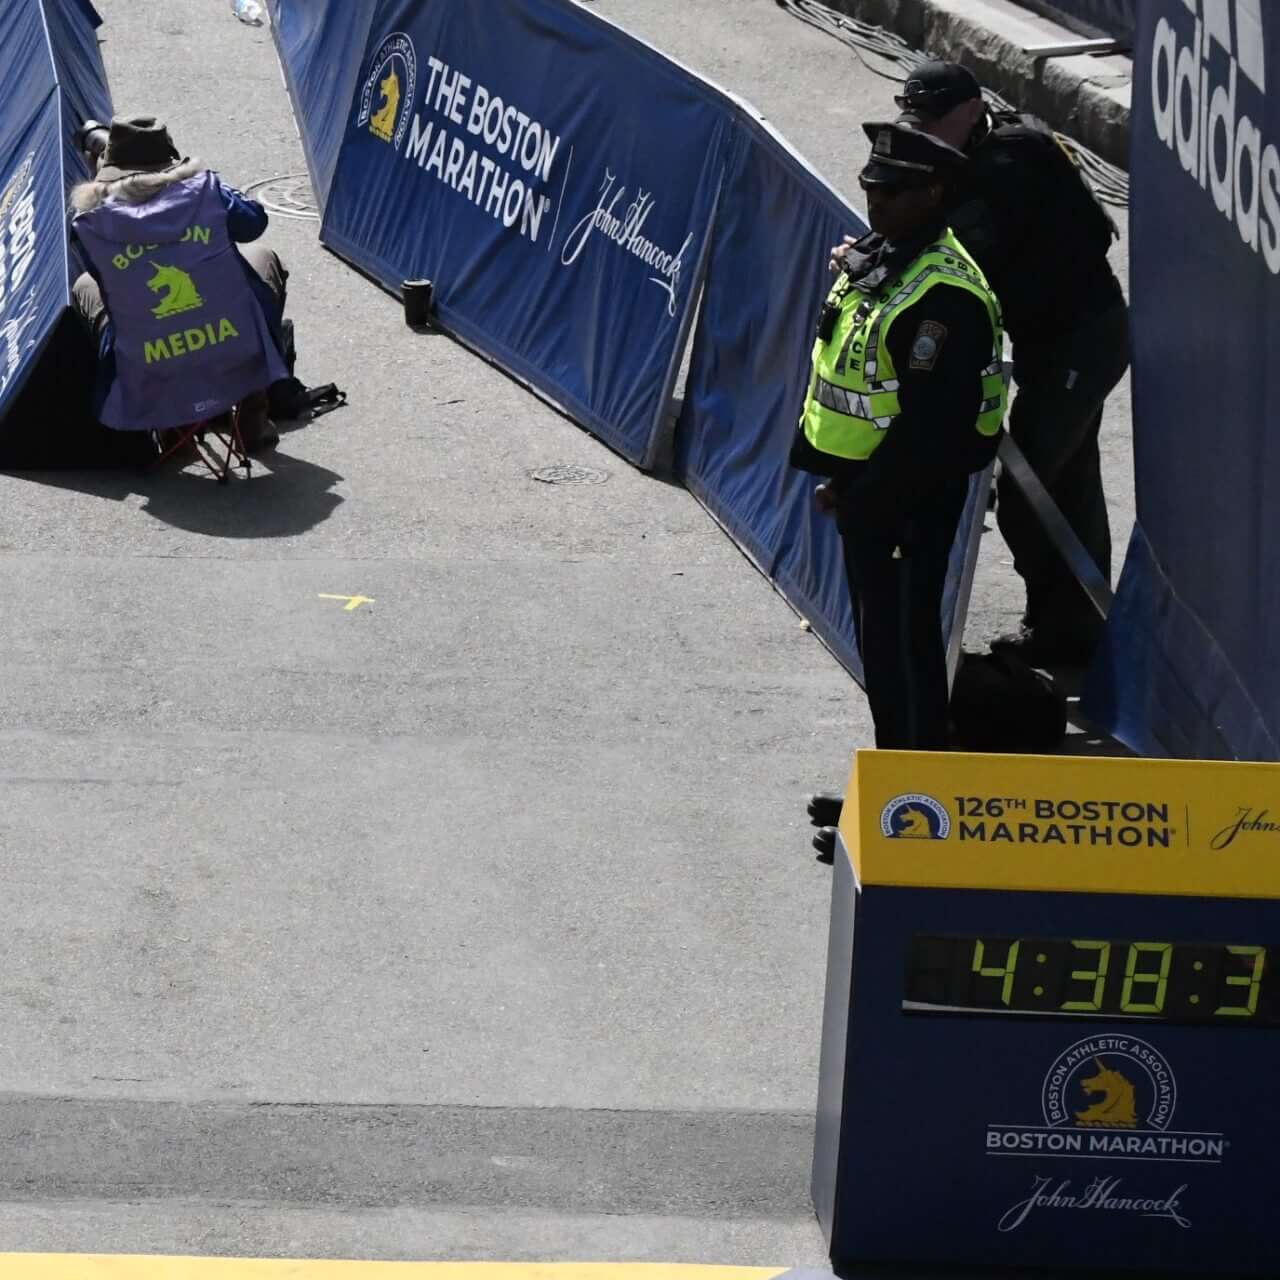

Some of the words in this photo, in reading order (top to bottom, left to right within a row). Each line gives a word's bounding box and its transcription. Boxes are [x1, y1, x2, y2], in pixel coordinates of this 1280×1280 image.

[424, 56, 471, 125] THE
[467, 85, 560, 182] BOSTON
[1151, 16, 1280, 275] adidas
[405, 114, 545, 242] MARATHON
[561, 168, 625, 266] John
[618, 187, 694, 318] Hancock
[144, 317, 239, 364] MEDIA
[954, 797, 1027, 818] 126TH
[1035, 800, 1169, 823] BOSTON
[959, 821, 1170, 848] MARATHON
[1048, 1065, 1068, 1120] BOSTON
[1066, 1039, 1128, 1066] ATHLETIC
[1129, 1044, 1171, 1124] ASSOCIATION
[986, 1131, 1082, 1151] BOSTON
[1090, 1135, 1223, 1156] MARATHON
[997, 1175, 1077, 1232] John
[1074, 1175, 1191, 1229] Hancock
